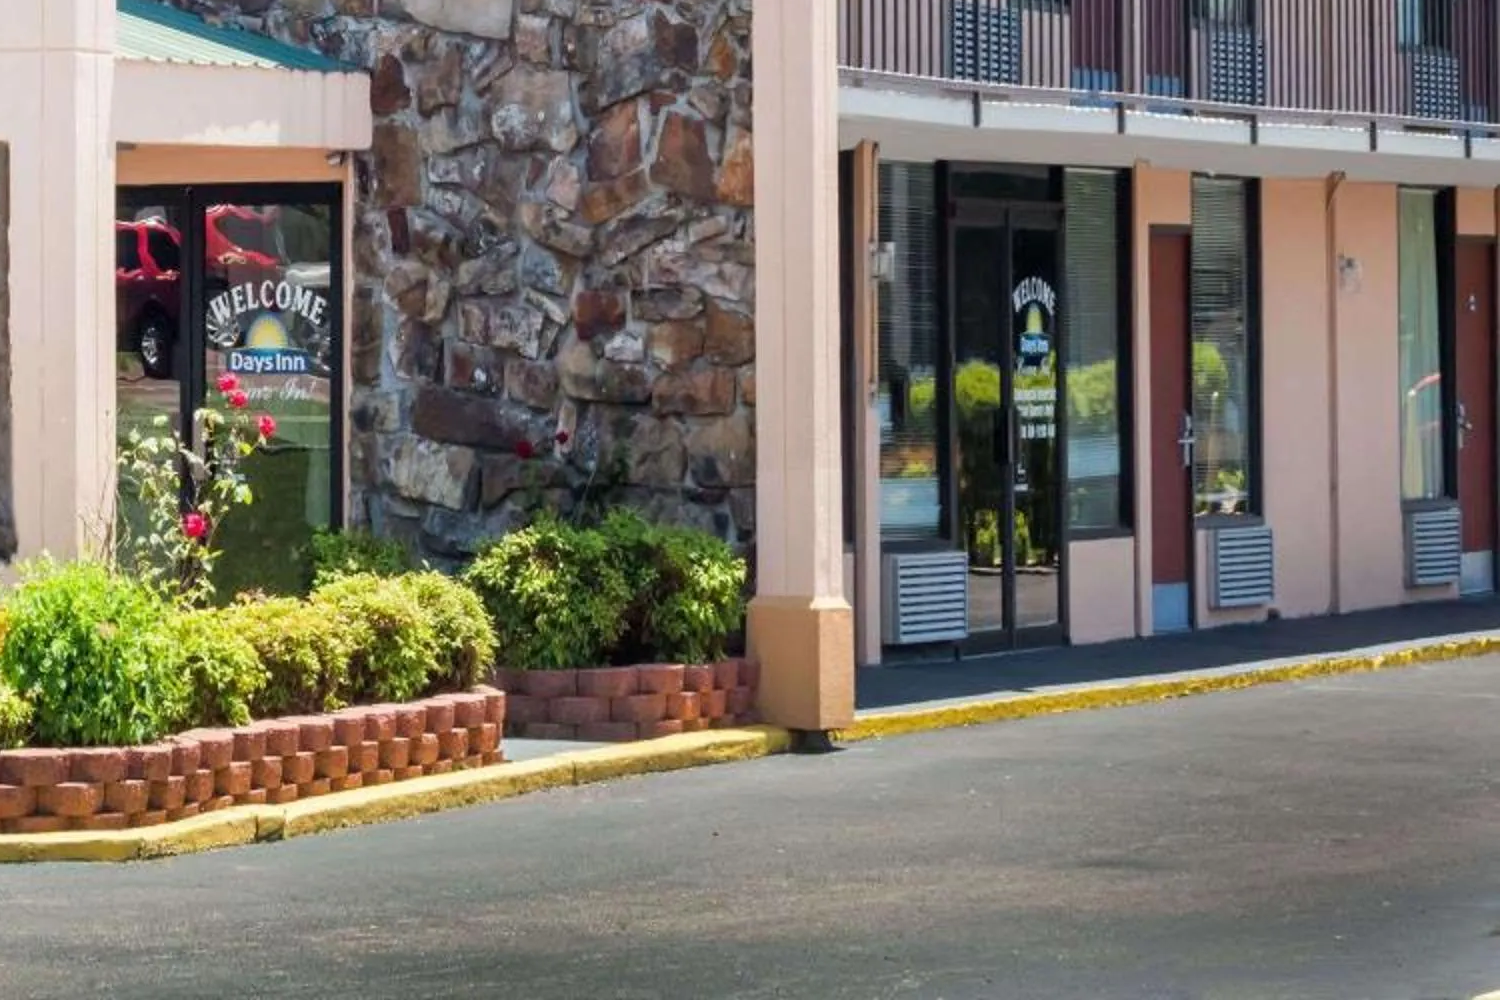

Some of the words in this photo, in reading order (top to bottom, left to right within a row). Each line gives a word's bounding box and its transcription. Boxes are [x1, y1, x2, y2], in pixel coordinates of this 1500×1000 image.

[210, 281, 327, 325] WELCOME
[1013, 276, 1057, 316] WELCOME
[230, 351, 274, 373] Days
[276, 352, 306, 371] Inn
